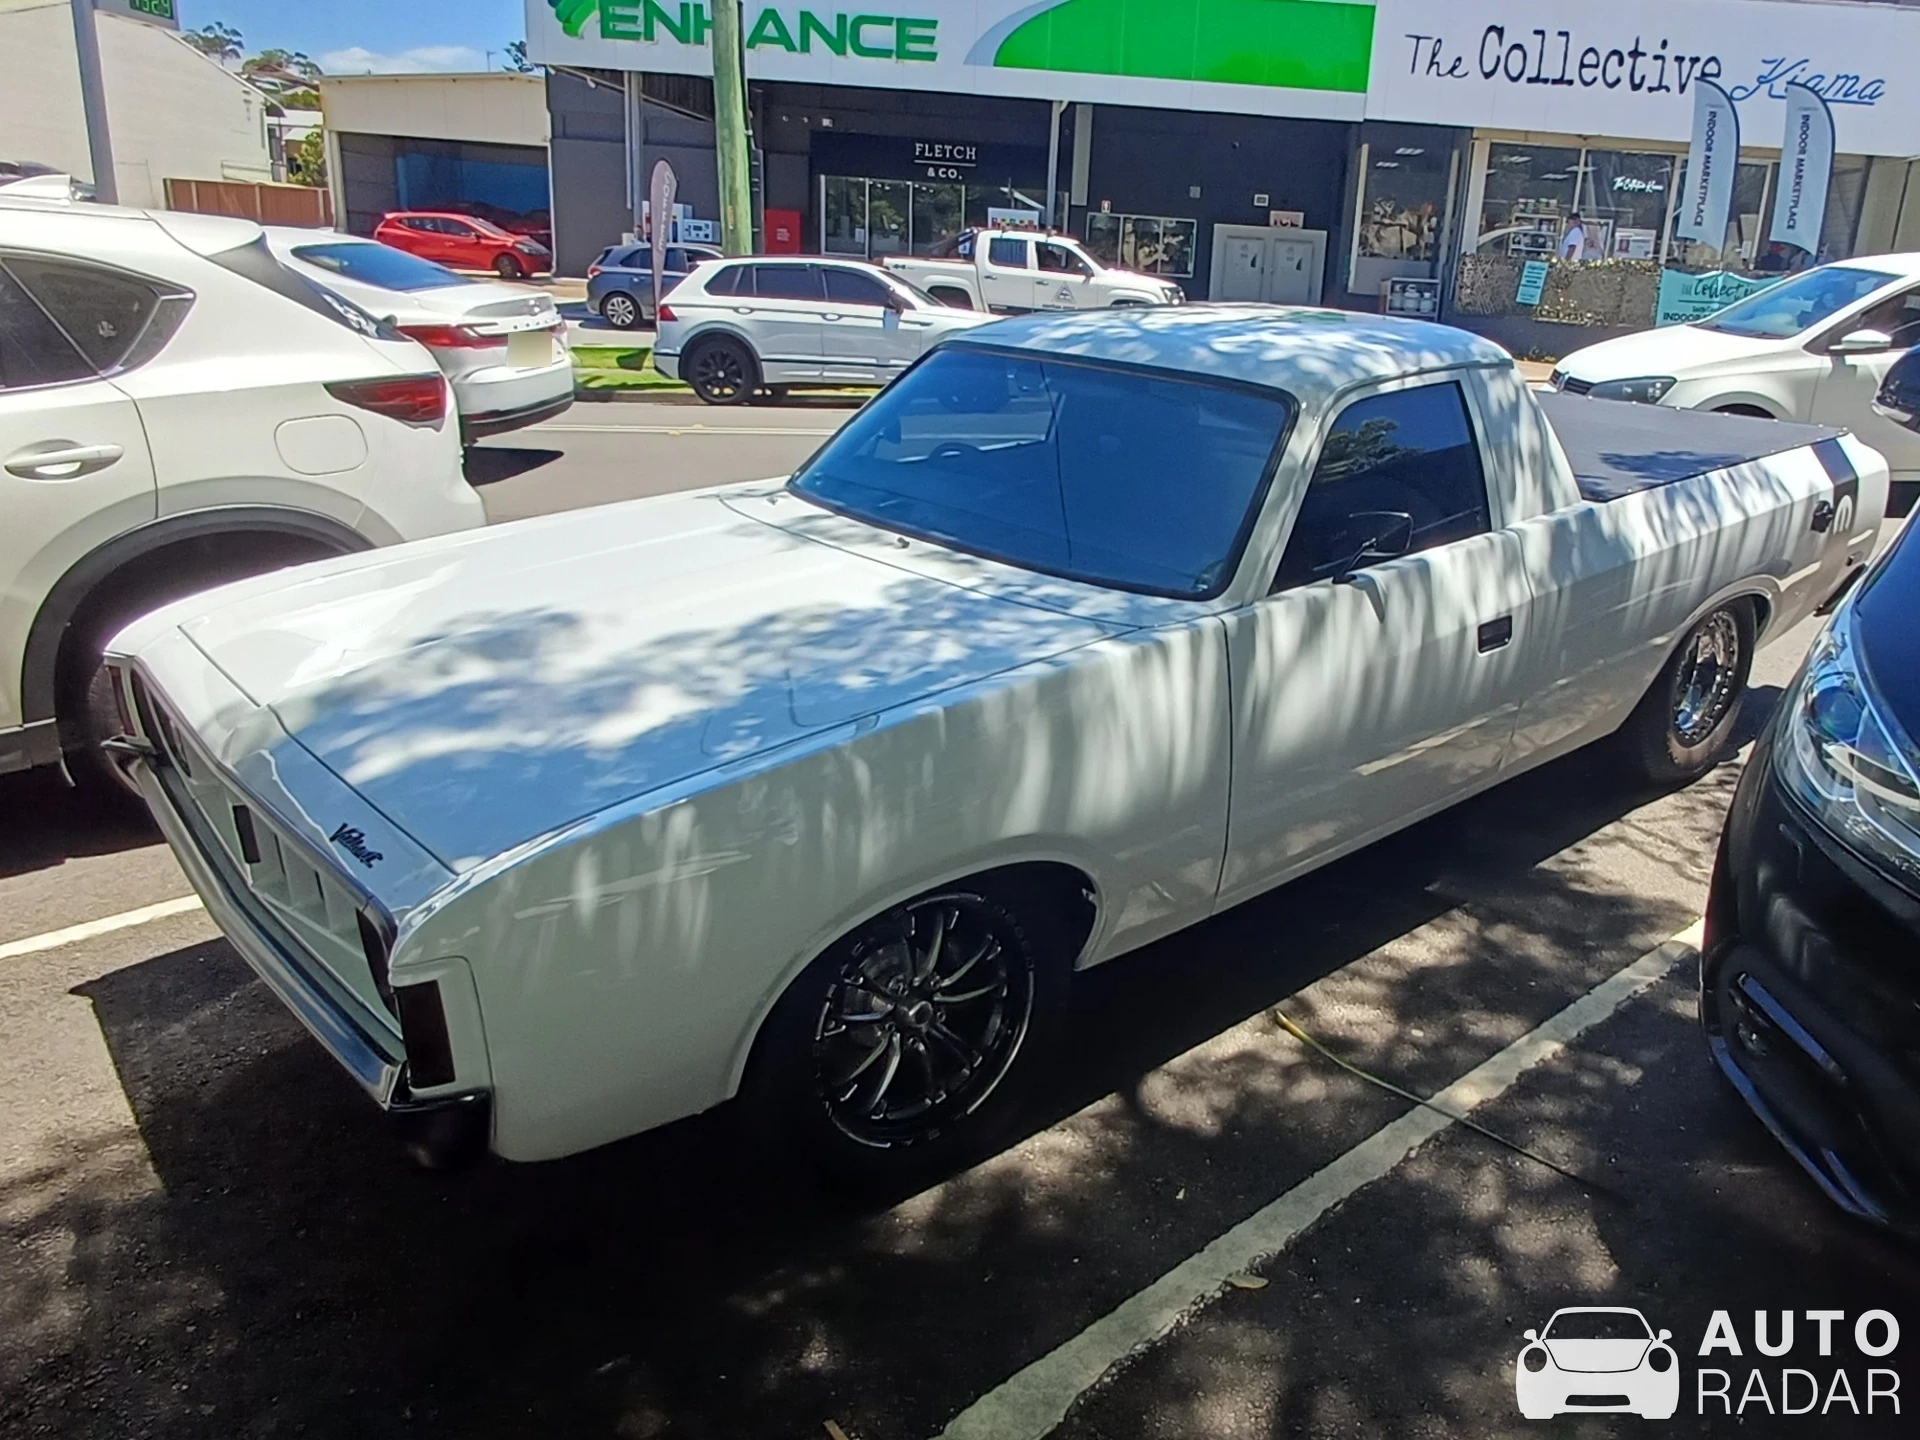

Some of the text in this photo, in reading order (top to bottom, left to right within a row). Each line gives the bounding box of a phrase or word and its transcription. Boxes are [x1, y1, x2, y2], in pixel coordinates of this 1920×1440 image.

[1404, 33, 1470, 79] The
[1478, 24, 1722, 95] Collective
[914, 142, 977, 160] FLETCH
[1704, 110, 1717, 153] INDOOR
[1798, 114, 1811, 155] INDOOR
[938, 168, 963, 180] CO.
[1693, 154, 1712, 227] MARKETPLACE
[1786, 157, 1806, 230] MARKETPLACE
